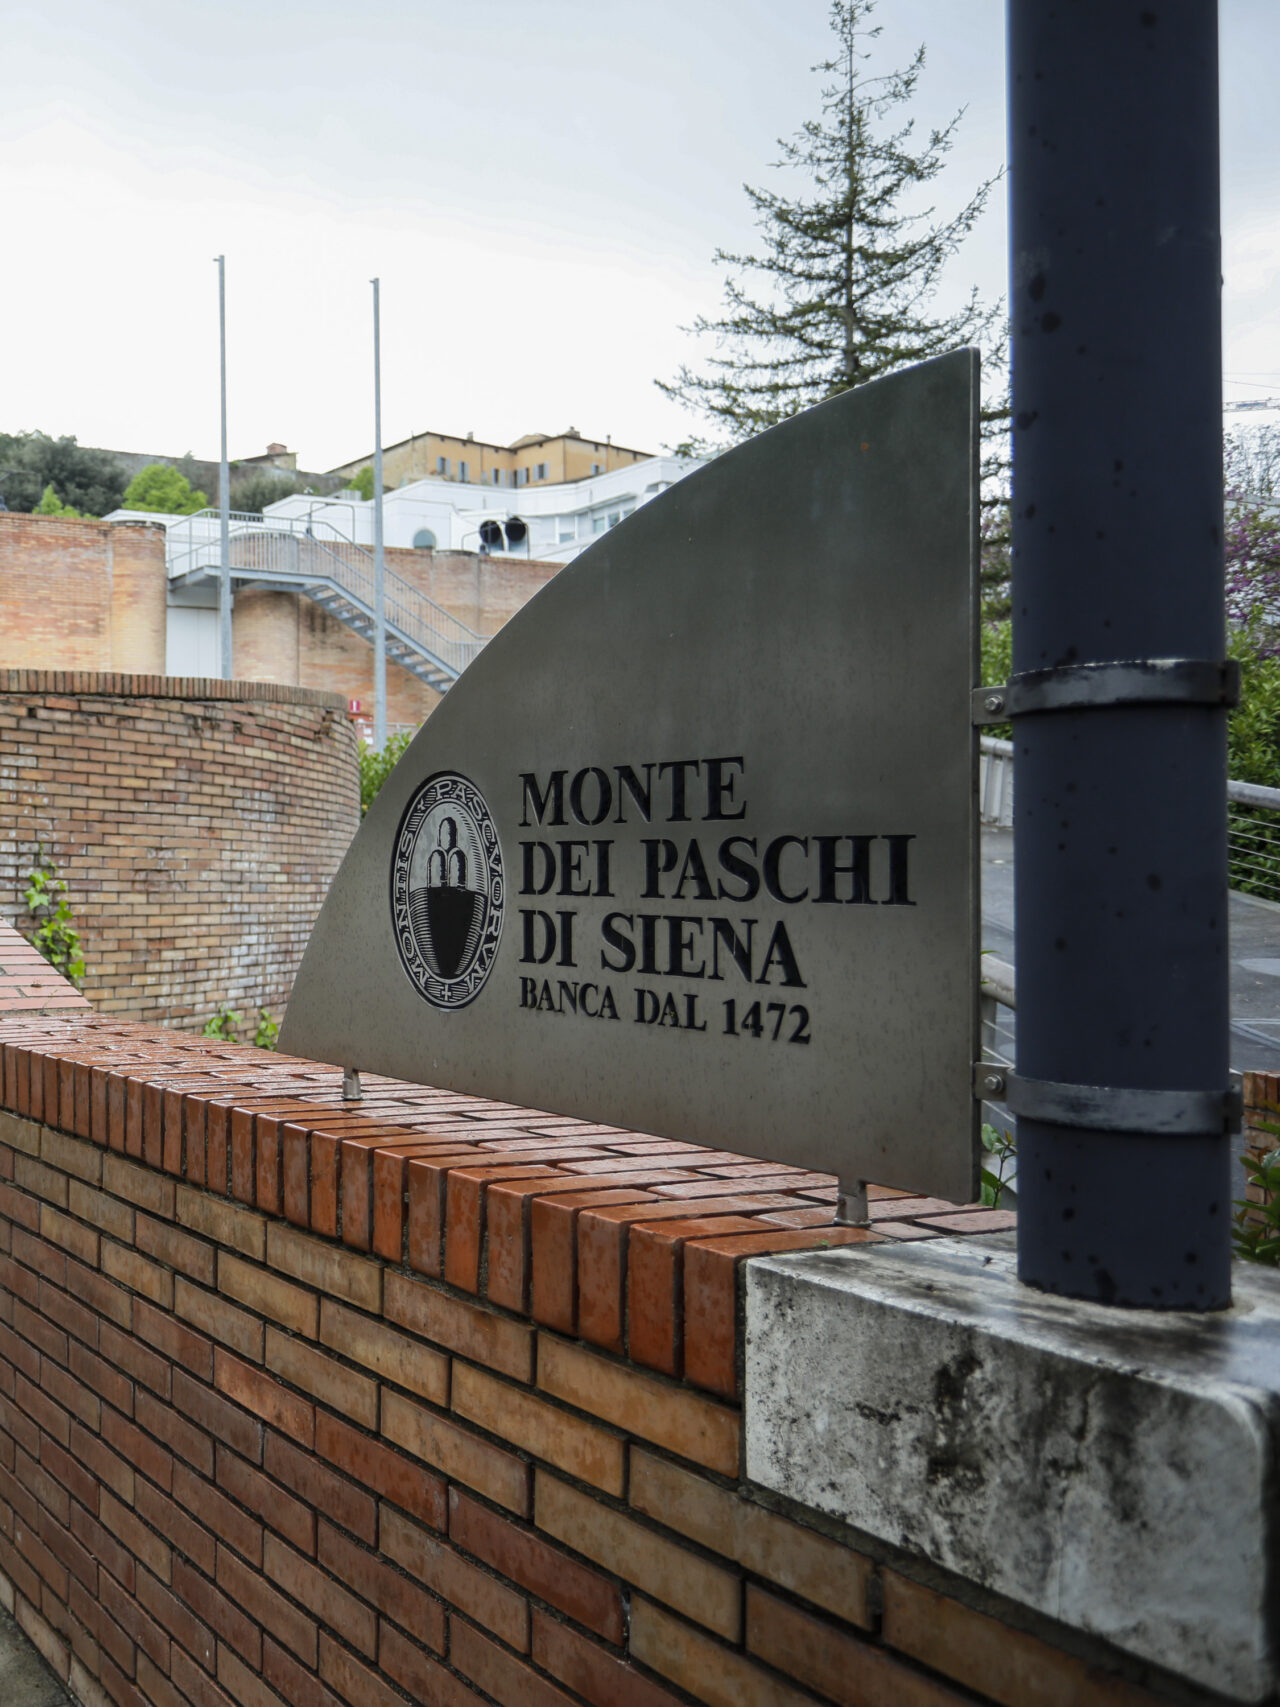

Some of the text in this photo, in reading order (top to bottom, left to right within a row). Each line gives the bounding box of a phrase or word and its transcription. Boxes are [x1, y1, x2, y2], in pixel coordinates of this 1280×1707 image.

[519, 756, 747, 827] MONTE
[519, 834, 918, 906] DEI PASCHI
[396, 830, 430, 988] MONTIS
[519, 909, 808, 988] DI SIENA
[519, 976, 812, 1044] BANCA DAL 1472
